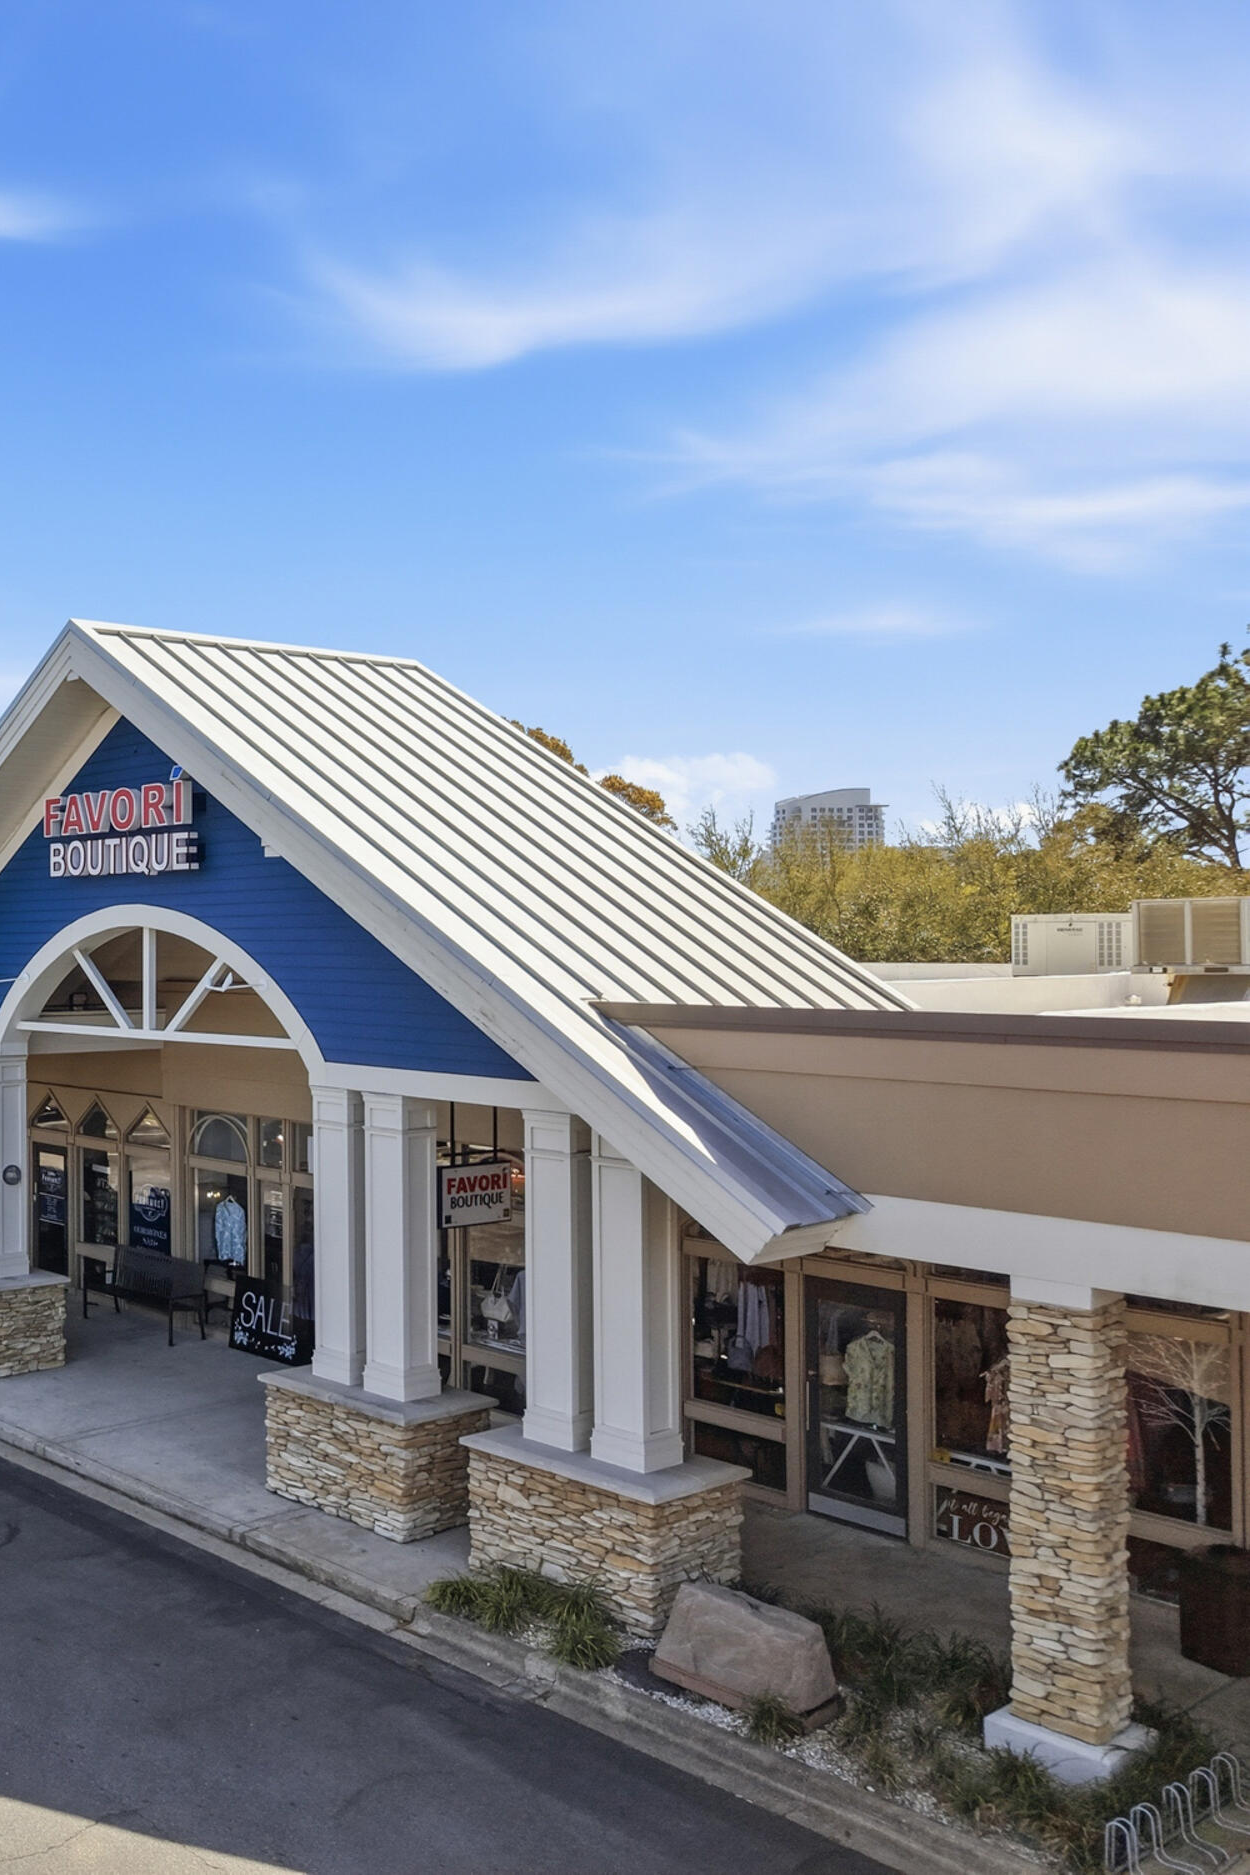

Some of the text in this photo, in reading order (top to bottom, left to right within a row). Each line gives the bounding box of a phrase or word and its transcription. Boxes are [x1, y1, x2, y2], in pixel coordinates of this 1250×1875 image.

[44, 765, 186, 838] FAVORÍ
[50, 832, 192, 877] BOUTIQUE
[450, 1192, 504, 1209] BOUTIQUE
[240, 1291, 292, 1341] SALE
[962, 1502, 978, 1516] all
[982, 1505, 1009, 1526] bega
